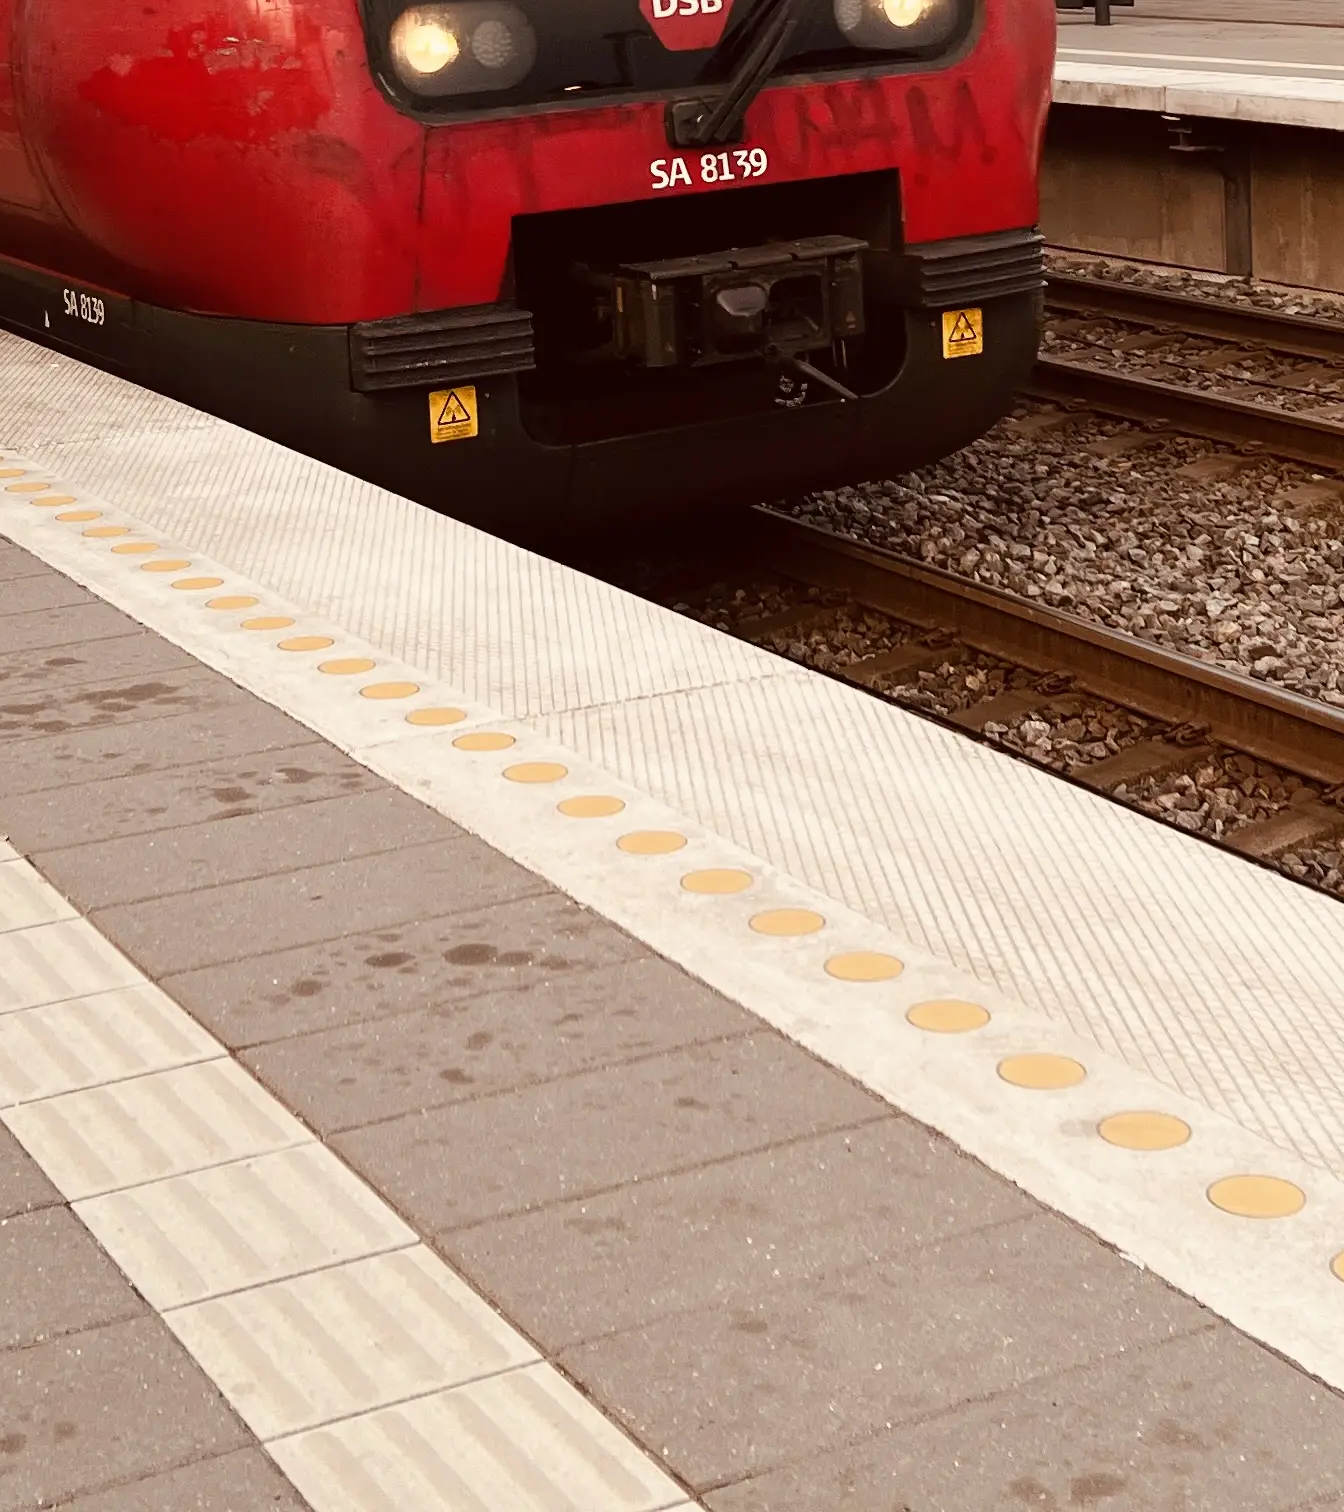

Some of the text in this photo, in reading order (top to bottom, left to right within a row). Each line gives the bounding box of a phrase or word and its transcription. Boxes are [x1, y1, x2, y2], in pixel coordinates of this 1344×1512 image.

[650, 148, 768, 189] SA 8139
[63, 288, 105, 326] SA 8139
